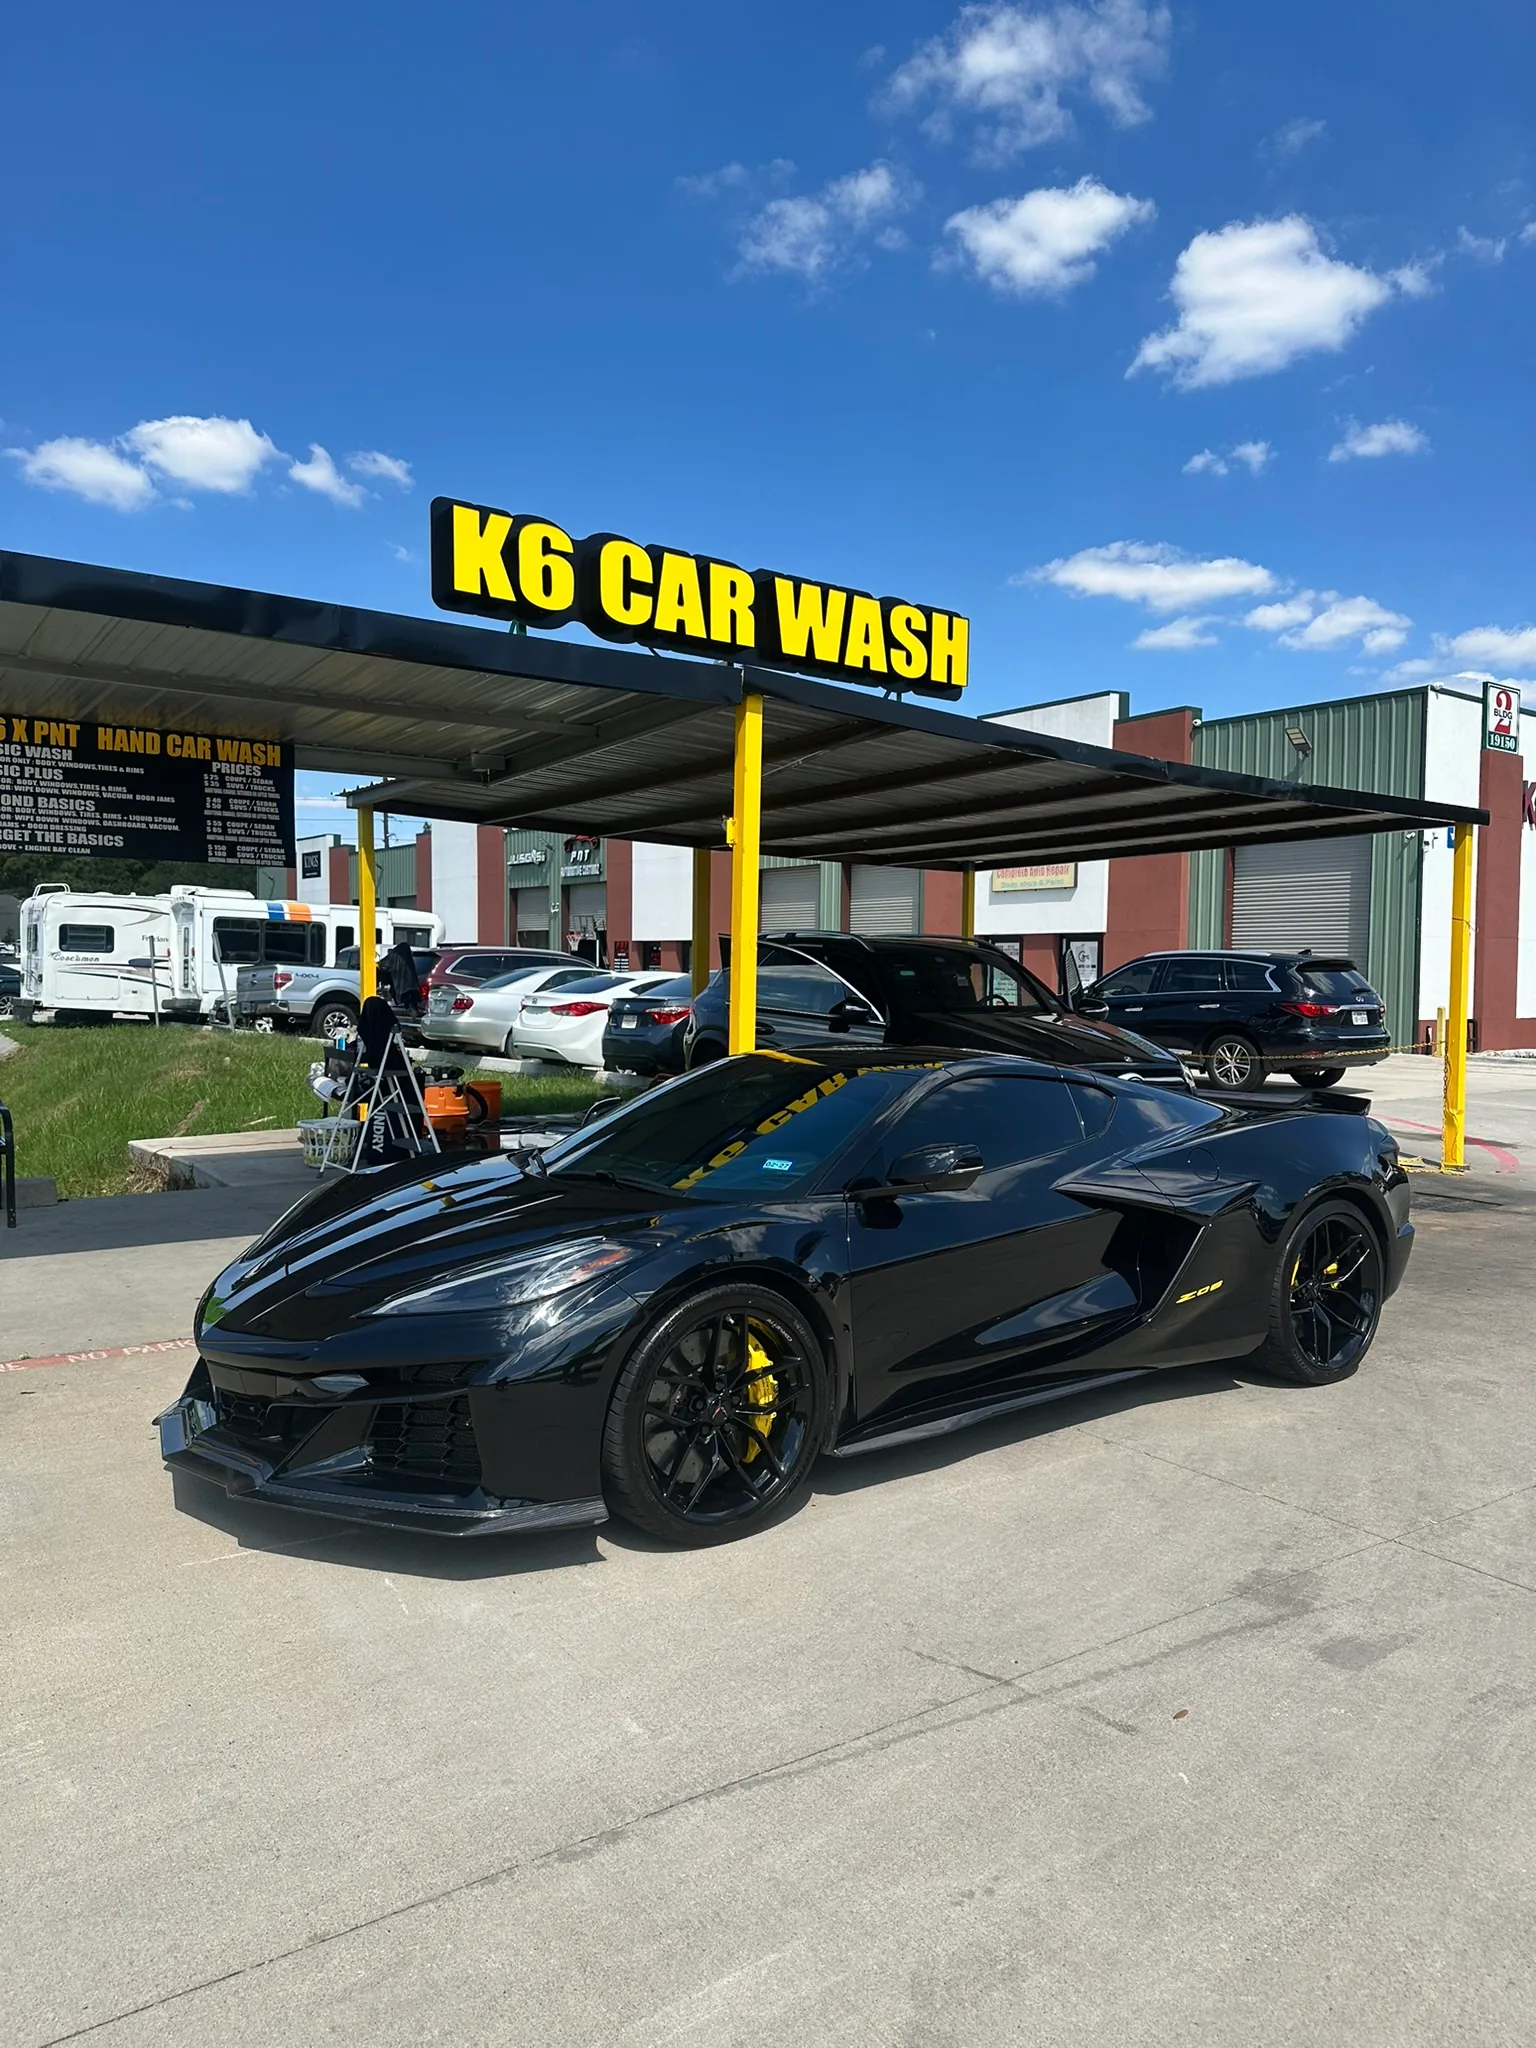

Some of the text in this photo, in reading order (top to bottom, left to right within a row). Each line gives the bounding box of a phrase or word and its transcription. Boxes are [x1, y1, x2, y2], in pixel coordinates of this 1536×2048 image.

[453, 505, 969, 687] K6 CAR WASH
[1494, 690, 1512, 735] 2
[1494, 708, 1513, 720] BLDG
[12, 718, 28, 743] X
[34, 720, 80, 747] PNT
[98, 727, 160, 755] HAND
[166, 733, 211, 760] CAR
[216, 738, 281, 767] WASH
[1490, 734, 1516, 750] 19150
[25, 745, 73, 761] WASH
[12, 757, 31, 765] ONLY
[126, 766, 145, 774] RIMS
[212, 761, 261, 777] PRICES
[24, 766, 63, 780] PLUS
[225, 775, 247, 783] COUPE
[108, 785, 127, 793] RIMS
[250, 784, 276, 792] TRUCKS
[1, 793, 96, 812] OND BASICS
[102, 792, 133, 800] VACUUM
[157, 795, 175, 803] JAMS
[229, 798, 250, 806] COUPE
[14, 814, 34, 822] WIPE
[103, 812, 122, 820] RIMS
[129, 814, 153, 822] LIQUID
[154, 816, 176, 824] SPRAY
[27, 822, 49, 830] DOOR
[50, 824, 87, 832] DRESSING
[0, 828, 124, 847] GET THE BASICS
[24, 844, 51, 852] ENGINE
[68, 846, 91, 854] CLEAN
[236, 845, 258, 853] COUPE
[1046, 865, 1070, 877] Repair
[53, 953, 100, 962] Coachmen
[66, 1350, 109, 1363] NO
